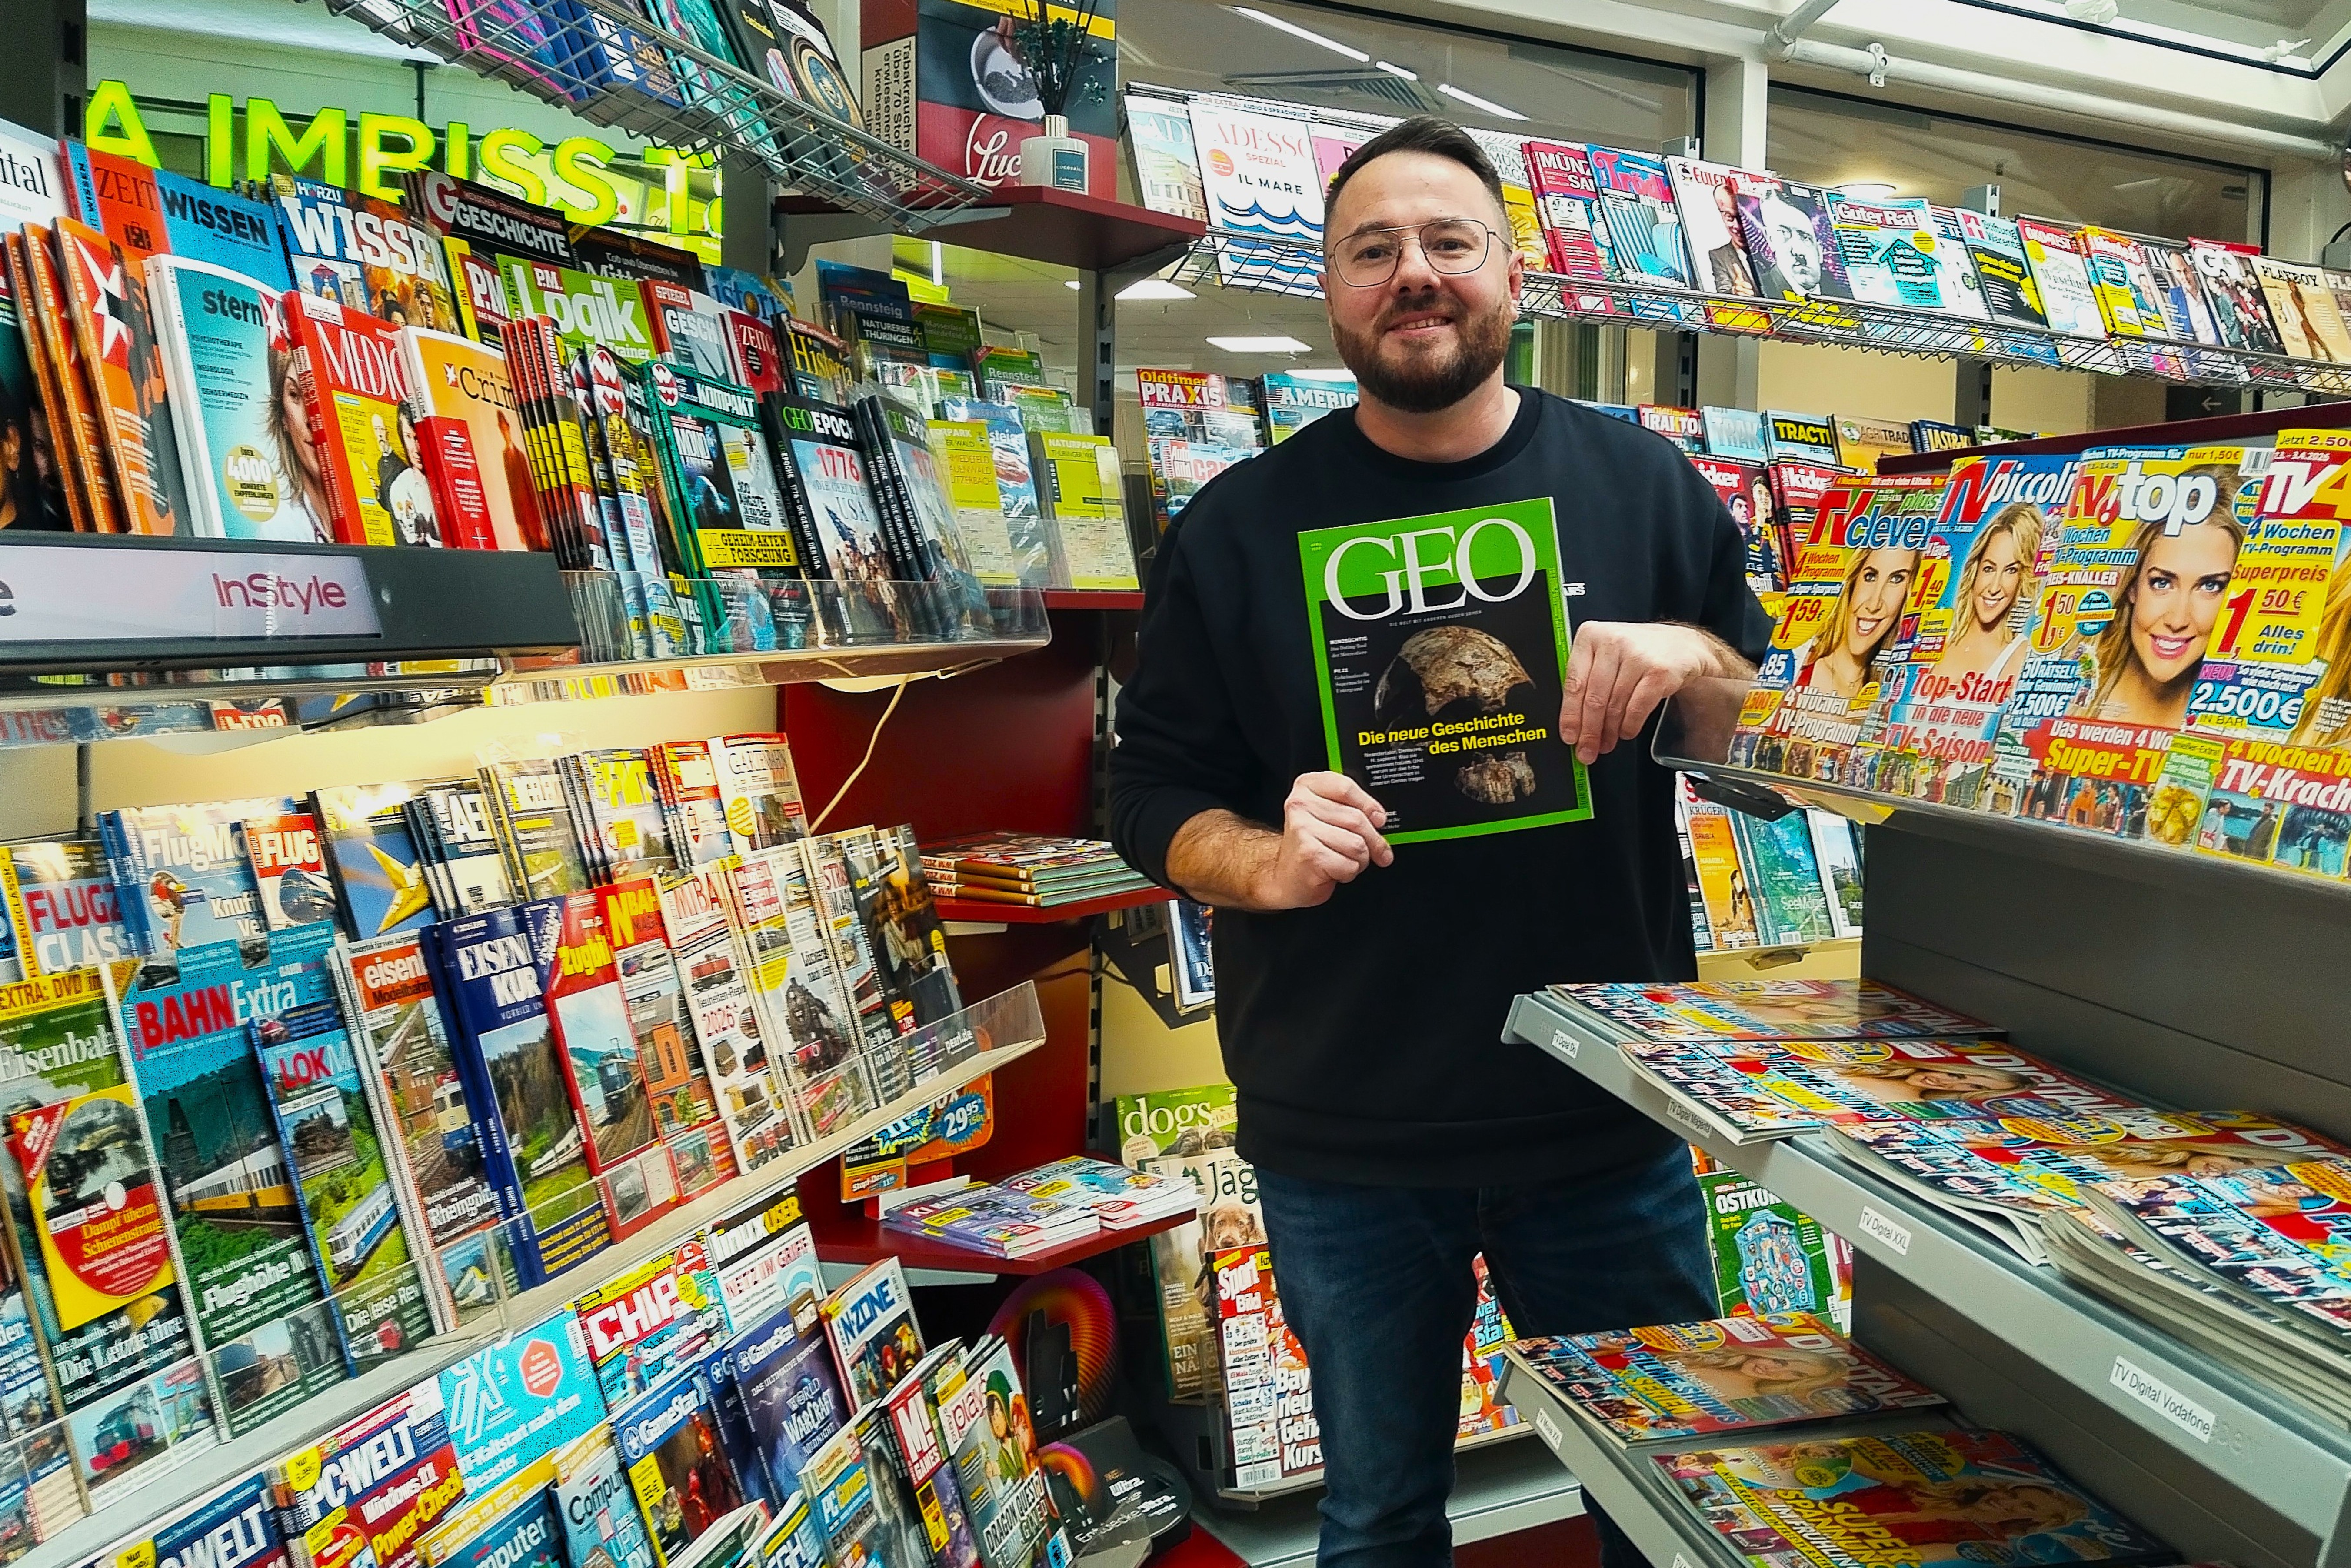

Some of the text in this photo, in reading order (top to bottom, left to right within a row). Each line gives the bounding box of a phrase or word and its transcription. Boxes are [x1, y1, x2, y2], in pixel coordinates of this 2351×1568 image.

[893, 49, 902, 108] über 70
[903, 40, 912, 134] Tabakrauch
[1246, 153, 1287, 168] SPEZIAL
[1238, 173, 1303, 195] IL MARE
[94, 166, 270, 246] ZEIT WISSEN
[1838, 203, 1915, 228] Guter Rat
[455, 201, 570, 257] GESCHICHTE
[2201, 248, 2241, 279] GQ
[2261, 265, 2318, 287] PLAYBOY
[534, 267, 563, 290] P.M.
[203, 289, 264, 326] stern
[512, 263, 647, 347] Logik
[655, 285, 690, 304] SPIEGEL
[839, 296, 903, 318] Rennsteig
[862, 319, 912, 335] NATURERBE
[864, 329, 914, 345] THÜRINGEN
[1140, 370, 1208, 386] Oldtimer
[697, 384, 756, 417] KOMPAKT
[1142, 383, 1222, 407] PRAXIS
[783, 407, 813, 430] GEO
[2107, 449, 2165, 459] TV-Programm
[2188, 449, 2241, 461] nur 1,50€
[2279, 435, 2304, 446] Jetzt
[228, 456, 272, 483] 4000
[816, 447, 860, 482] 1776
[1937, 460, 2018, 524] TV
[2117, 462, 2217, 537] top
[2264, 462, 2341, 515] TV
[834, 496, 869, 521] USA
[1807, 489, 1876, 546] TV
[721, 533, 787, 548] GEHEIM-AKTEN
[2063, 528, 2110, 543] Wochen
[2248, 516, 2335, 540] 4 Wochen
[731, 548, 791, 564] FORSCHUNG
[1807, 552, 1839, 563] Wochen
[2243, 543, 2333, 557] TV-Programm
[1324, 517, 1536, 621] GEO
[1800, 566, 1845, 578] Programm
[2232, 563, 2329, 583] Superpreis
[212, 572, 347, 616] InStyle
[2259, 624, 2304, 640] Alles
[2253, 639, 2295, 655] drin!
[1766, 653, 1788, 676] 85
[2201, 664, 2238, 681] NEU!
[1911, 666, 2014, 706] Top-Start
[1912, 705, 1984, 727] in die neue
[2012, 694, 2070, 717] 2.500€
[2190, 682, 2303, 726] 2.500€
[1358, 712, 1525, 746] Die neue Geschichte
[1776, 707, 1861, 746] TV-Programm
[2050, 720, 2146, 746] Das werden 4
[2216, 716, 2244, 728] BAR
[1429, 725, 1547, 756] des Menschen
[1884, 723, 1994, 765] TV-Saison
[2043, 737, 2168, 783] Super-TV
[2227, 741, 2242, 758] 4
[2243, 742, 2330, 774] Wochen
[1689, 806, 1723, 816] KRÜGER
[261, 830, 320, 868] FLUG
[53, 974, 83, 997] DVD
[134, 979, 296, 1049] BAHN Extra
[278, 1046, 332, 1089] LOK
[944, 1101, 979, 1138] 29 95
[1124, 1097, 1212, 1139] dogs
[1012, 1182, 1034, 1191] KI
[81, 1217, 121, 1239] Dampf
[1862, 1212, 1908, 1249] TV Digital XXL
[1218, 1252, 1260, 1301] Sport
[586, 1272, 678, 1358] CHIP
[840, 1278, 897, 1340] N-ZONE
[1235, 1292, 1262, 1313] Bild
[1174, 1343, 1197, 1359] EIN
[2115, 1362, 2211, 1435] TV Digital Vodafone
[639, 1390, 699, 1445] GameStar
[914, 1446, 942, 1479] GAMES
[360, 1477, 419, 1524] Windows
[372, 1465, 464, 1565] Power-Check
[985, 1506, 1019, 1555] DRAGON
[1818, 1500, 1923, 1565] SUPER
